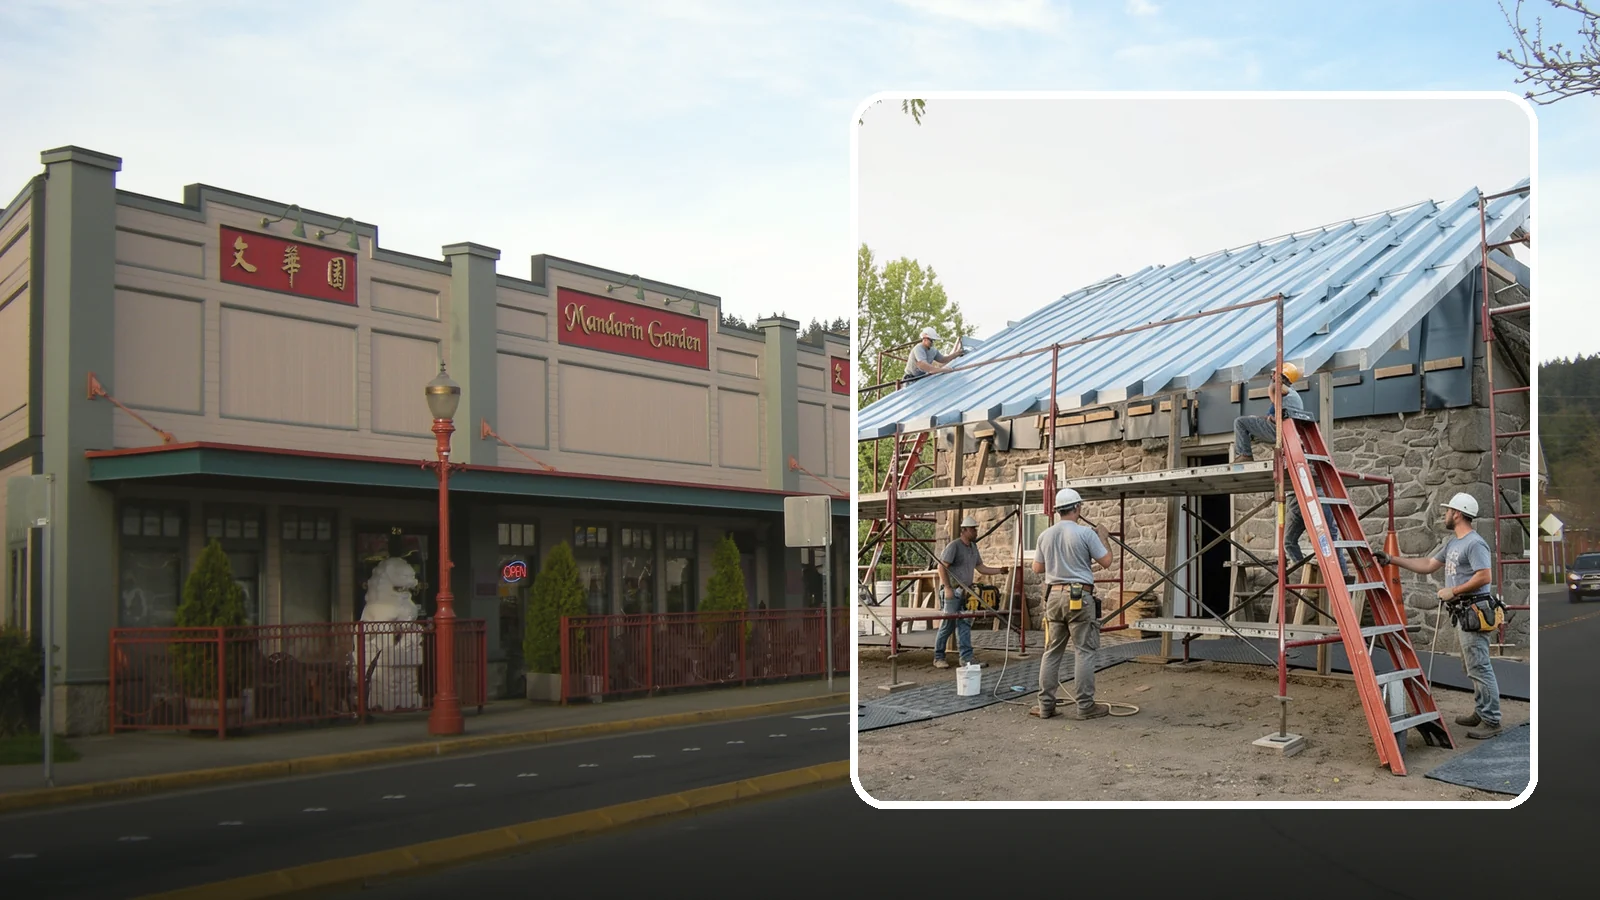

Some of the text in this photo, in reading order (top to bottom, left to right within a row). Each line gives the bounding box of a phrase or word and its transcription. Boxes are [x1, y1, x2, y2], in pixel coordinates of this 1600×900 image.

[564, 302, 701, 352] Mandarin Garden
[503, 565, 527, 578] OPEN
